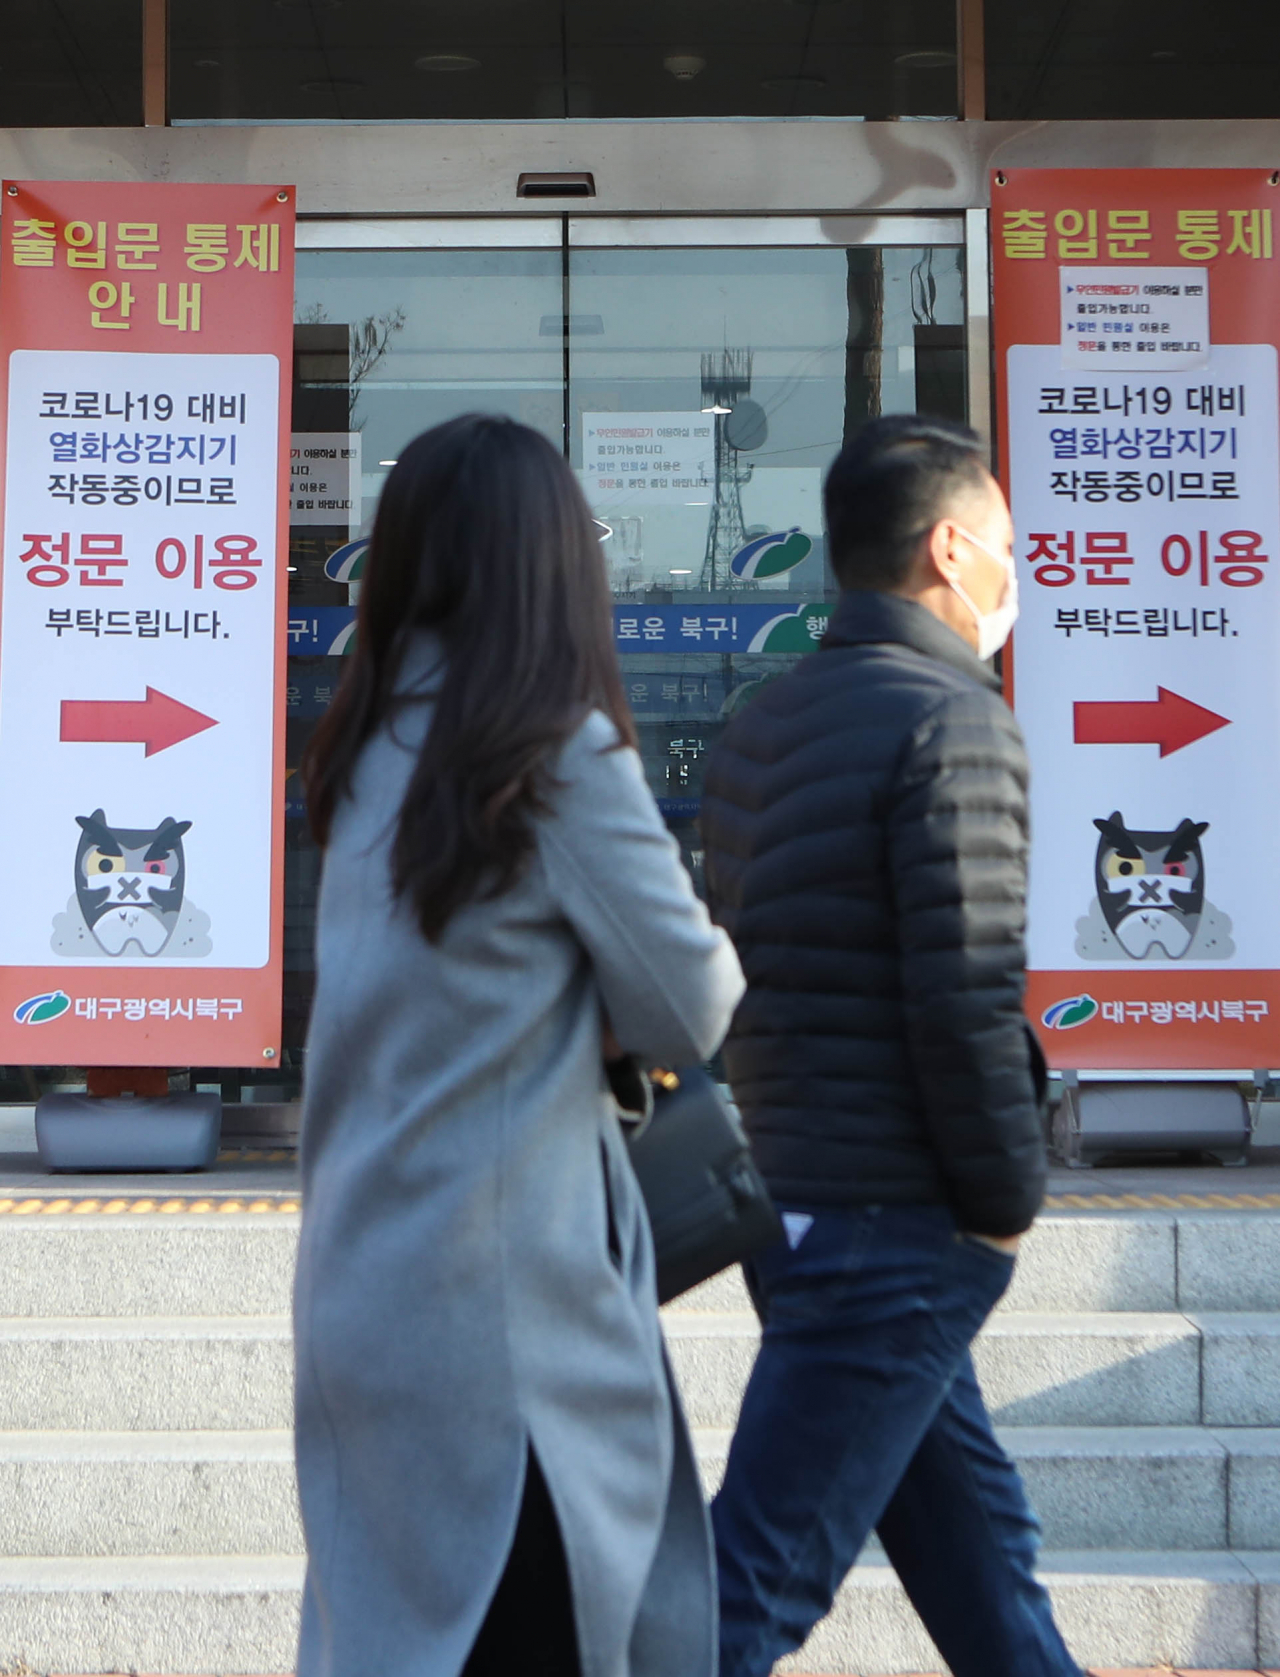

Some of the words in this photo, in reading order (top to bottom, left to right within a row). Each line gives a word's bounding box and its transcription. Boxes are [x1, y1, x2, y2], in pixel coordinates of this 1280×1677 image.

[11, 218, 161, 271] 출입문
[184, 224, 280, 272] 통제
[1003, 209, 1151, 260] 출입문
[1175, 209, 1273, 260] 통제
[89, 281, 135, 330] 안
[158, 283, 202, 332] 내
[1139, 323, 1170, 333] 이용은
[1137, 342, 1156, 352] 출입
[39, 392, 173, 422] 코로나19
[188, 393, 245, 424] 대비
[1038, 385, 1172, 416] 코로나19
[1187, 385, 1244, 416] 대비
[50, 432, 236, 465] 열화상감지기
[304, 449, 336, 458] 이용하실
[1050, 428, 1236, 459] 열화상감지기
[653, 461, 681, 471] 이용은
[48, 474, 236, 506] 작동중이므로
[300, 483, 327, 492] 이용은
[650, 478, 667, 488] 출입
[1050, 470, 1239, 502] 작동중이므로
[297, 500, 313, 509] 출입
[19, 532, 128, 587] 정문
[155, 535, 262, 591] 이용
[1026, 531, 1134, 587] 정문
[1161, 530, 1269, 587] 이용
[45, 609, 229, 639] 부탁드립니다.
[611, 617, 665, 640] 로운
[680, 617, 737, 640] 북구!
[1054, 608, 1238, 637] 부탁드립니다.
[75, 998, 243, 1021] 대구광역시북구
[1101, 1000, 1268, 1024] 대구광역시북구
